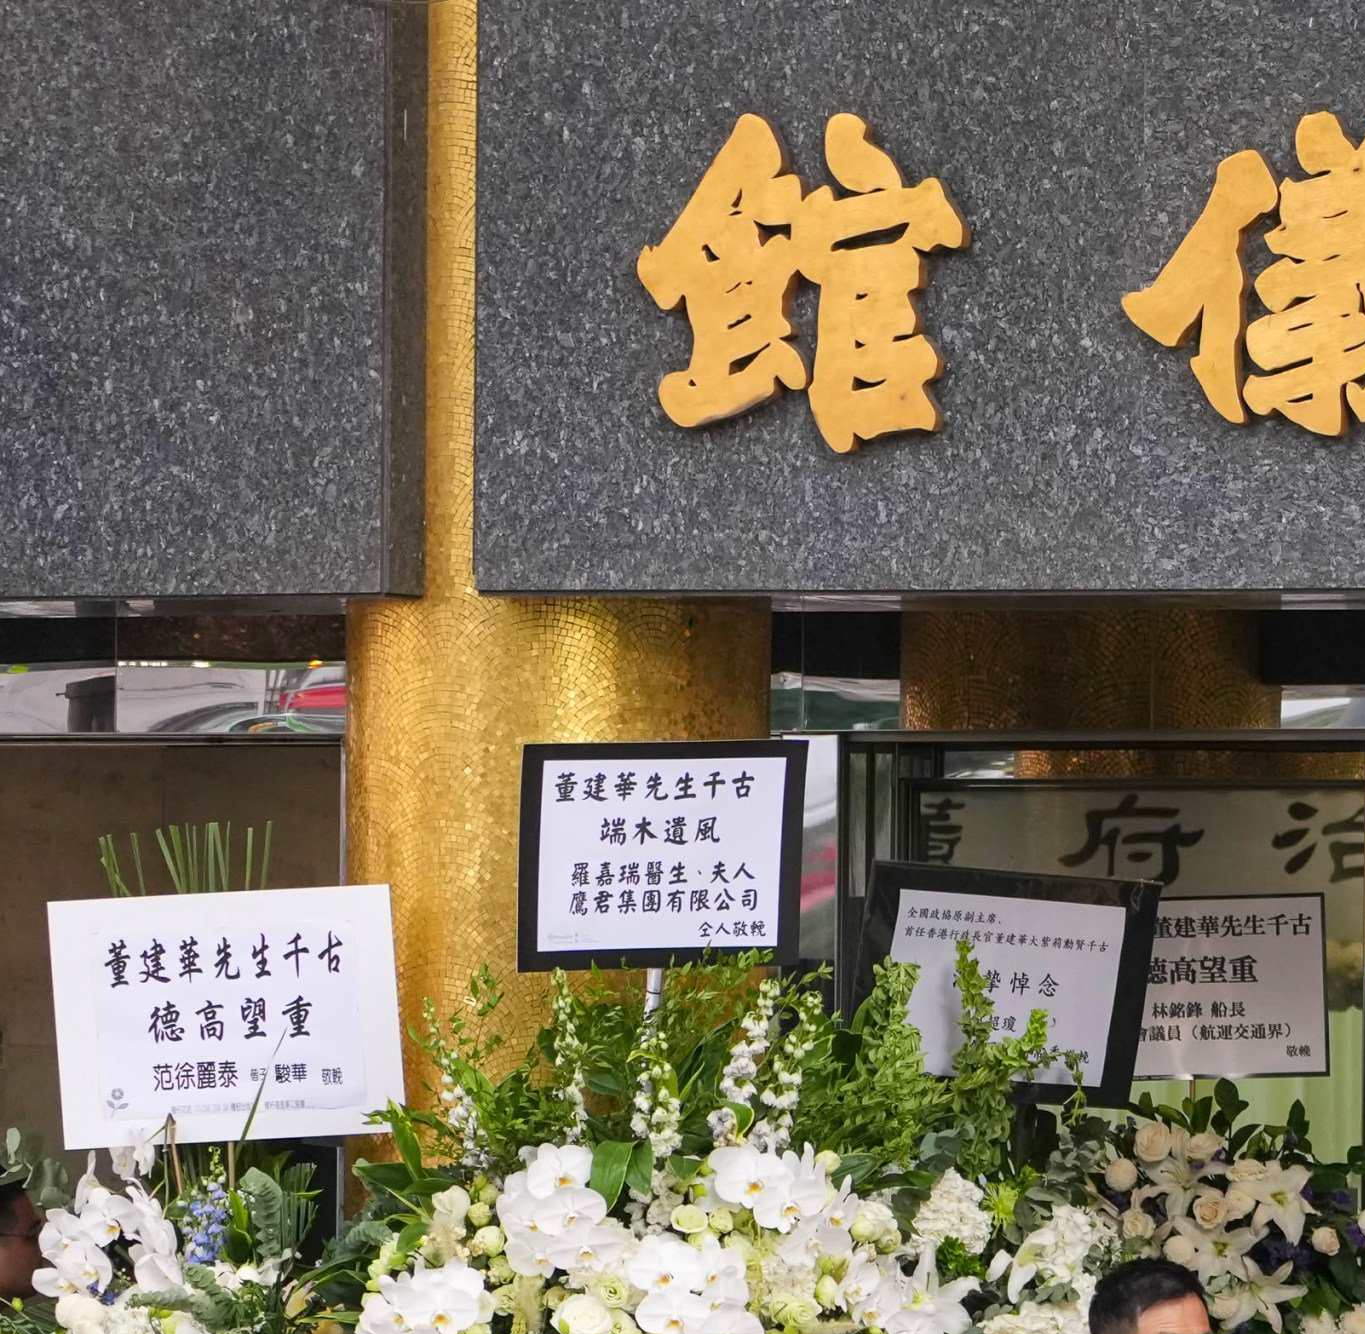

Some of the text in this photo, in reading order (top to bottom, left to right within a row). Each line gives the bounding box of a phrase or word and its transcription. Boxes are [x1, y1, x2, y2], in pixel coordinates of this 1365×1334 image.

[554, 770, 756, 803] 董建華先生千古
[599, 816, 721, 846] 端木遺風
[570, 861, 756, 887] 羅嘉瑞醫生、夫人
[568, 888, 759, 916] 鷹君集團有限公司
[1153, 912, 1313, 939] 董建華先生千古
[104, 930, 343, 988] 董建華先生千古
[953, 969, 1060, 998] 摯悼念
[147, 995, 313, 1043] 德高望重
[1151, 1001, 1246, 1019] 林銘鋒 船長
[153, 1060, 239, 1092] 范徐麗泰
[275, 1063, 308, 1084] 駿華
